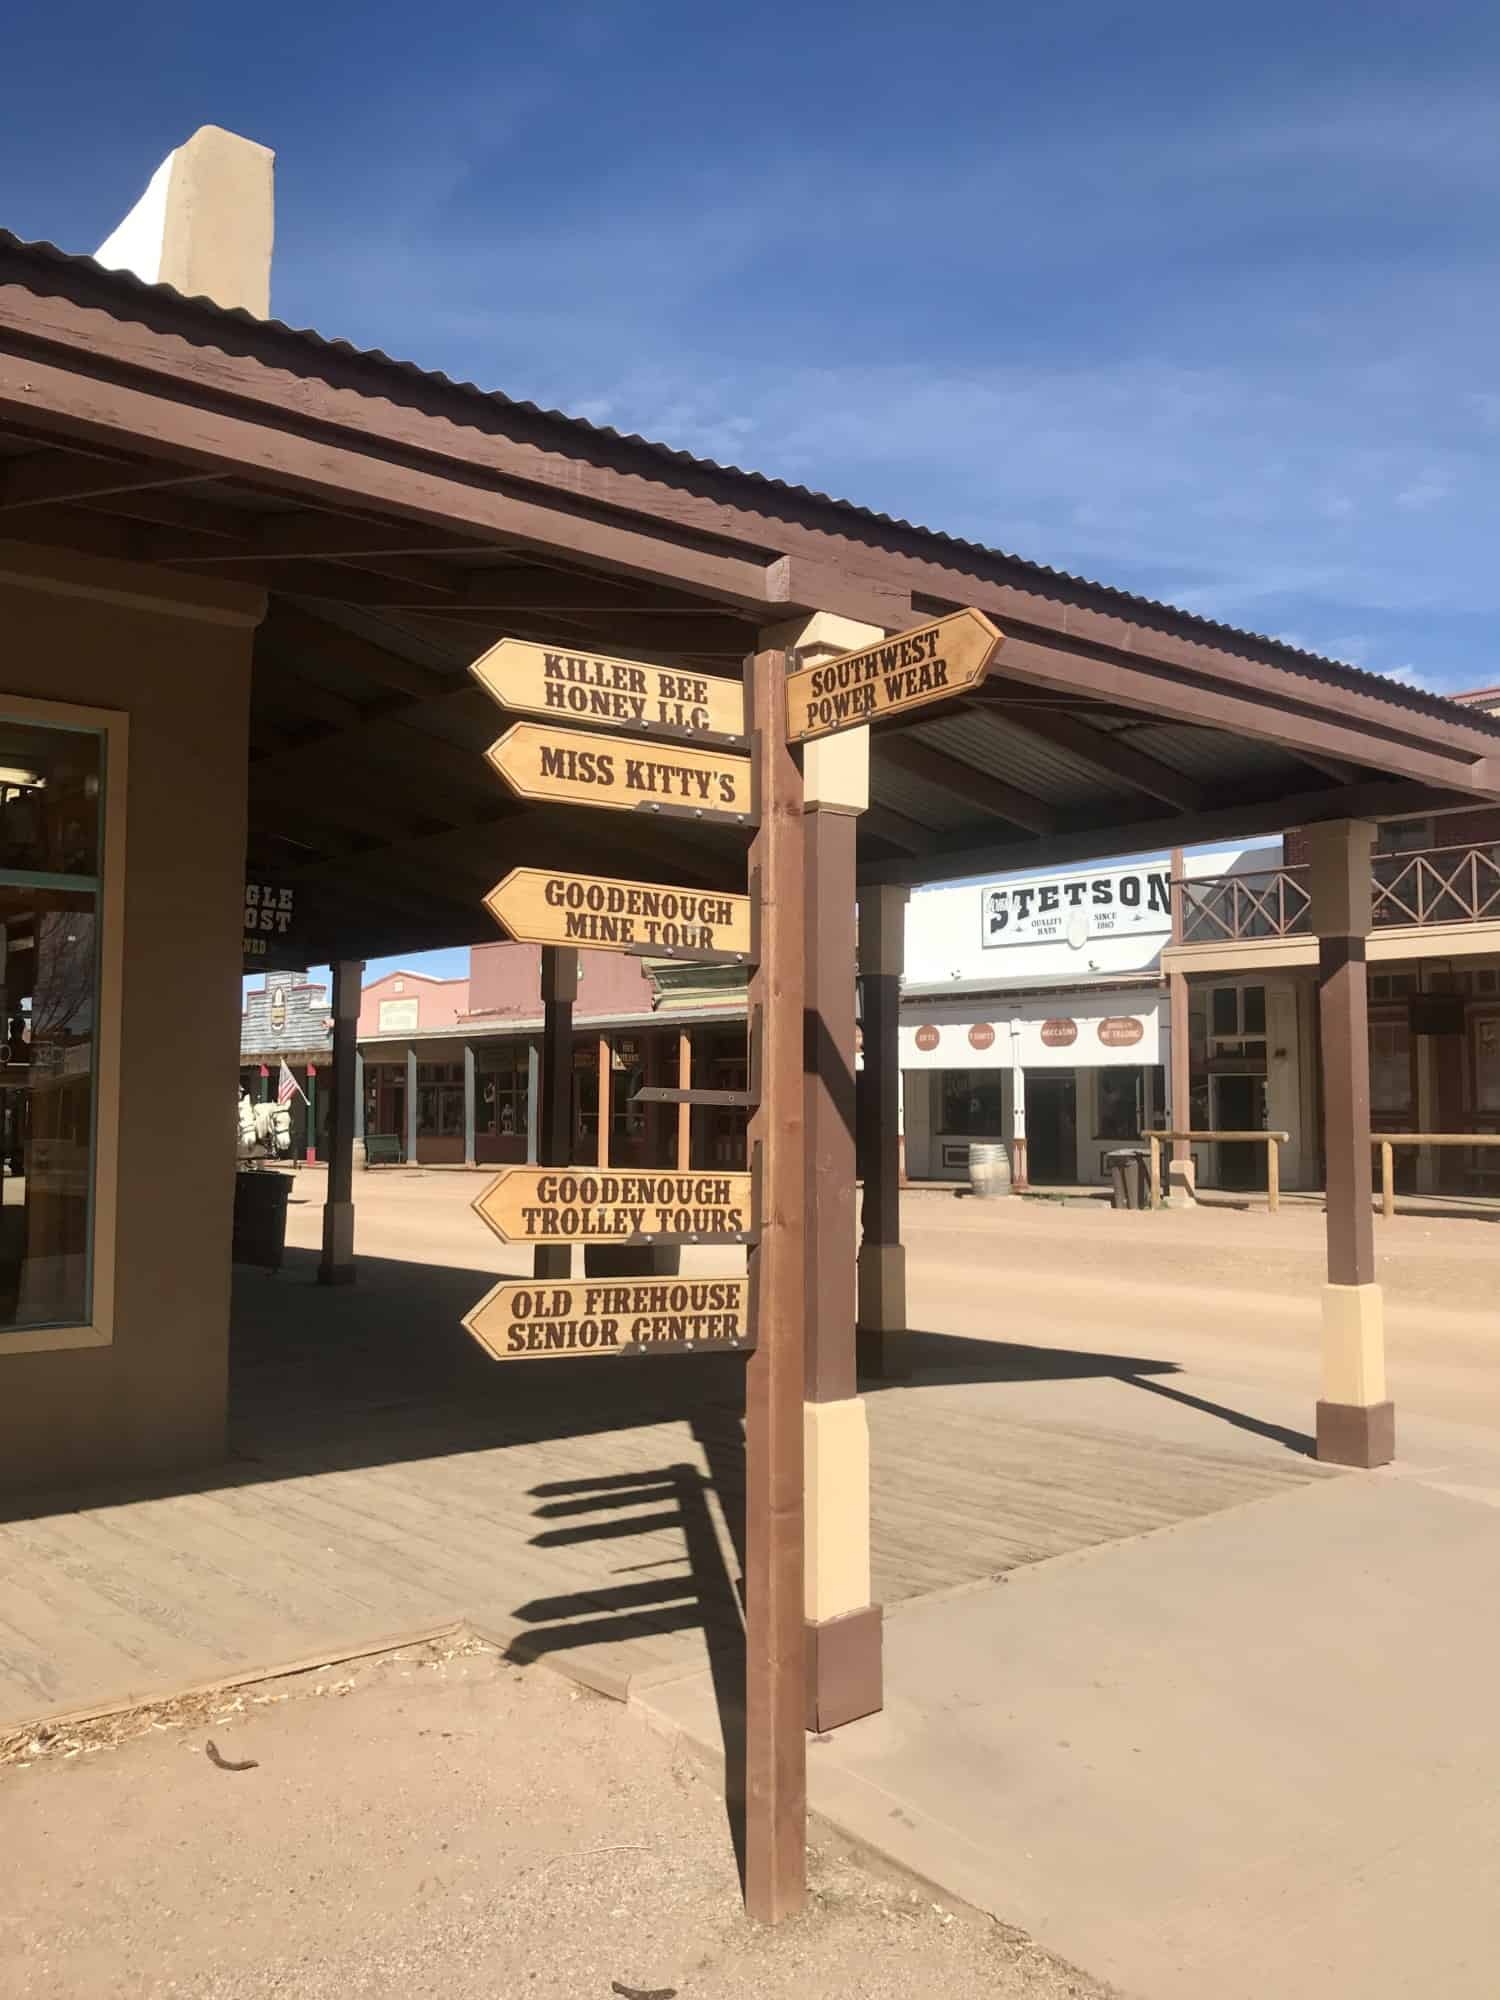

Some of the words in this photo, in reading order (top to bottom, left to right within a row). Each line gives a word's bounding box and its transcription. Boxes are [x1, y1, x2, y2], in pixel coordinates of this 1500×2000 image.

[544, 653, 648, 694] KILLER
[658, 673, 708, 704] BEE
[811, 629, 939, 698] SOUTHWEST
[544, 681, 647, 719] HONEY
[658, 701, 709, 730] LLC
[807, 683, 877, 728] POWER
[884, 659, 948, 702] WEAR
[540, 746, 614, 785] MISS
[625, 759, 736, 802] KITTY'S
[544, 880, 733, 925] GOODENOUGH
[990, 872, 1172, 934] STETSON
[565, 912, 634, 944] MINE
[644, 920, 714, 950] TOUR
[536, 1176, 732, 1205] GOODENOUGH
[521, 1207, 646, 1235] TROLLEY
[656, 1208, 743, 1233] TOURS
[511, 1290, 572, 1319] OLD
[584, 1283, 741, 1317] FIREHOUSE
[507, 1318, 619, 1352] SENIOR
[631, 1313, 739, 1343] CENTER
